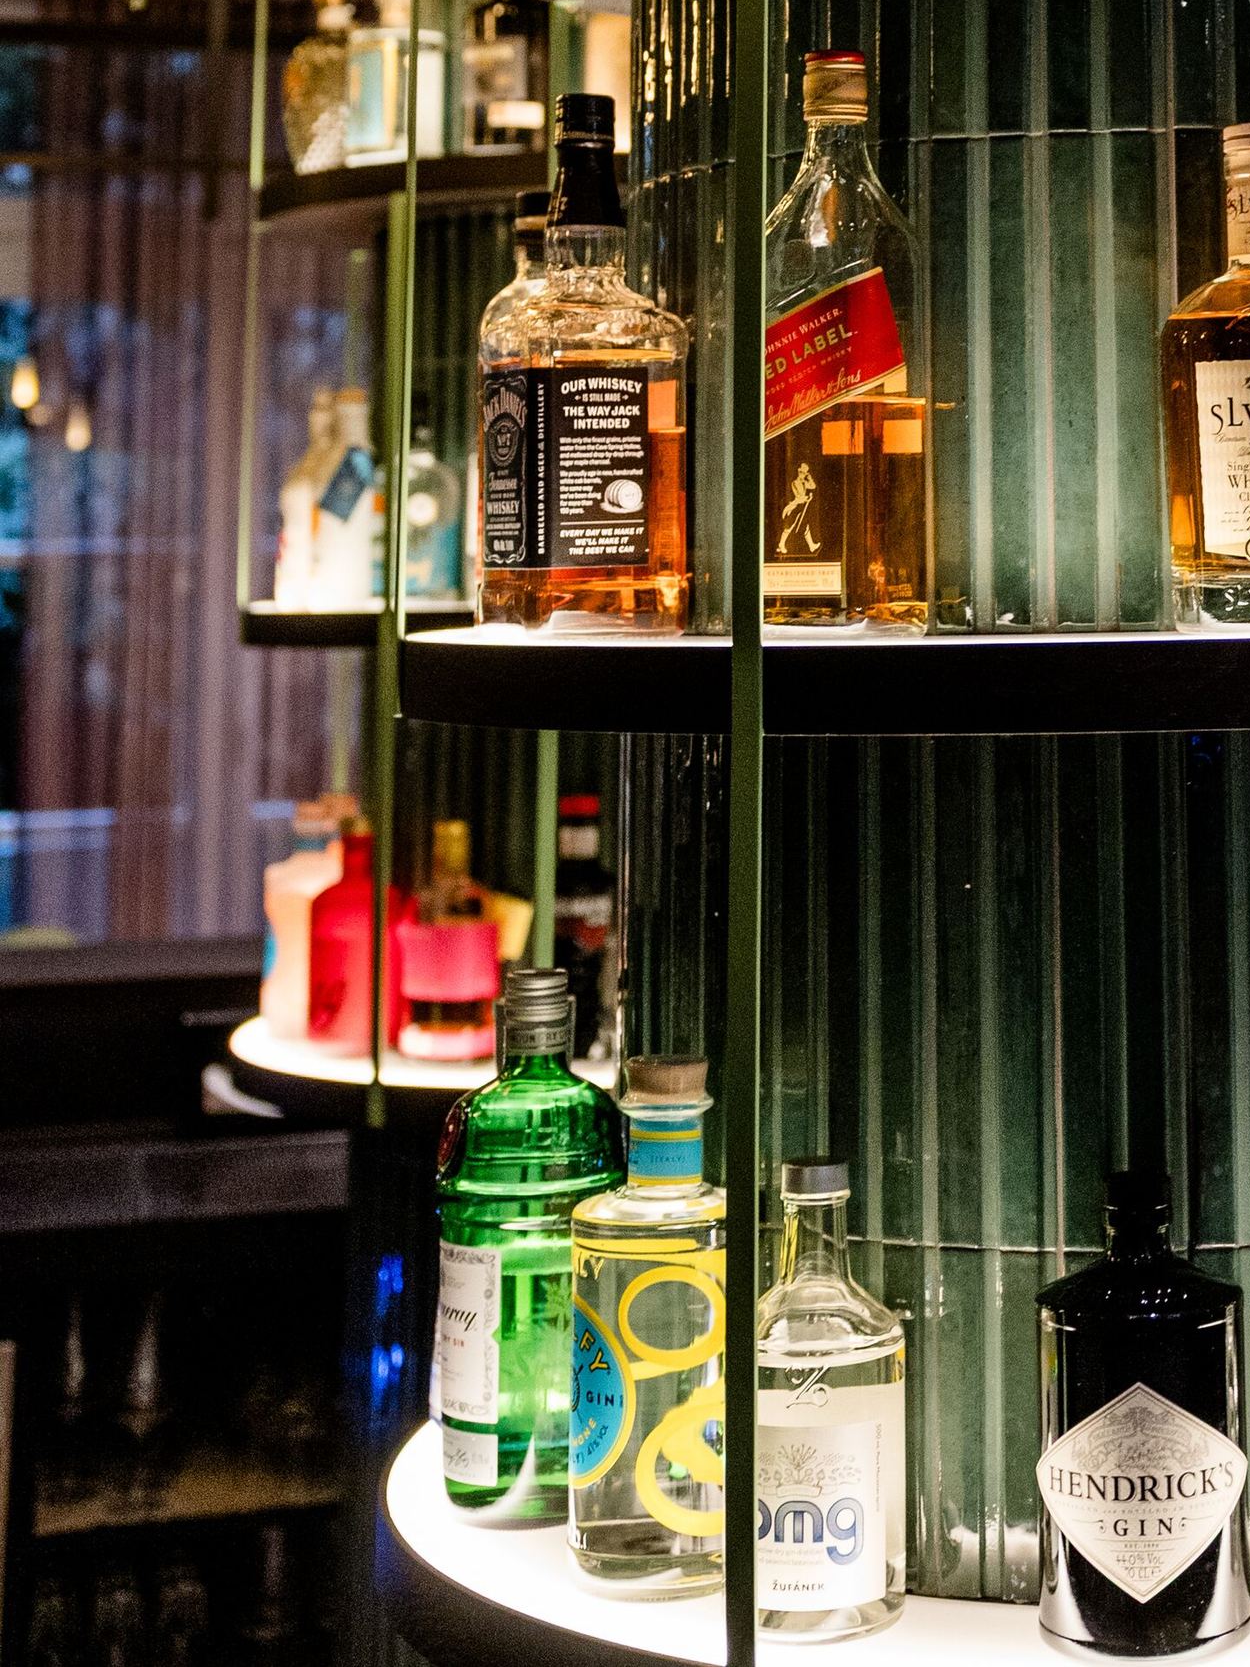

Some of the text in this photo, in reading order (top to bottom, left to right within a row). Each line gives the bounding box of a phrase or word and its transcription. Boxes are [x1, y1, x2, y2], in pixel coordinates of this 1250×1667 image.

[798, 307, 841, 334] WALKER
[765, 324, 852, 381] ED LABEL
[561, 377, 642, 395] OUR WHISKEY
[582, 393, 621, 402] IS STILL MADE
[562, 405, 640, 417] THE WAY JACK
[574, 418, 630, 429] INTENDED
[486, 501, 520, 515] WHISKEY
[560, 527, 644, 538] EVERY DAY WE MAKE IT
[598, 537, 620, 545] MAKE
[620, 537, 629, 545] IT
[569, 545, 634, 555] THE BEST WE CAN
[586, 1390, 615, 1407] GIN
[1049, 1461, 1234, 1503] HENDRICK'S
[1113, 1517, 1174, 1537] GIN
[772, 1579, 826, 1592] ŽUFÁNEK
